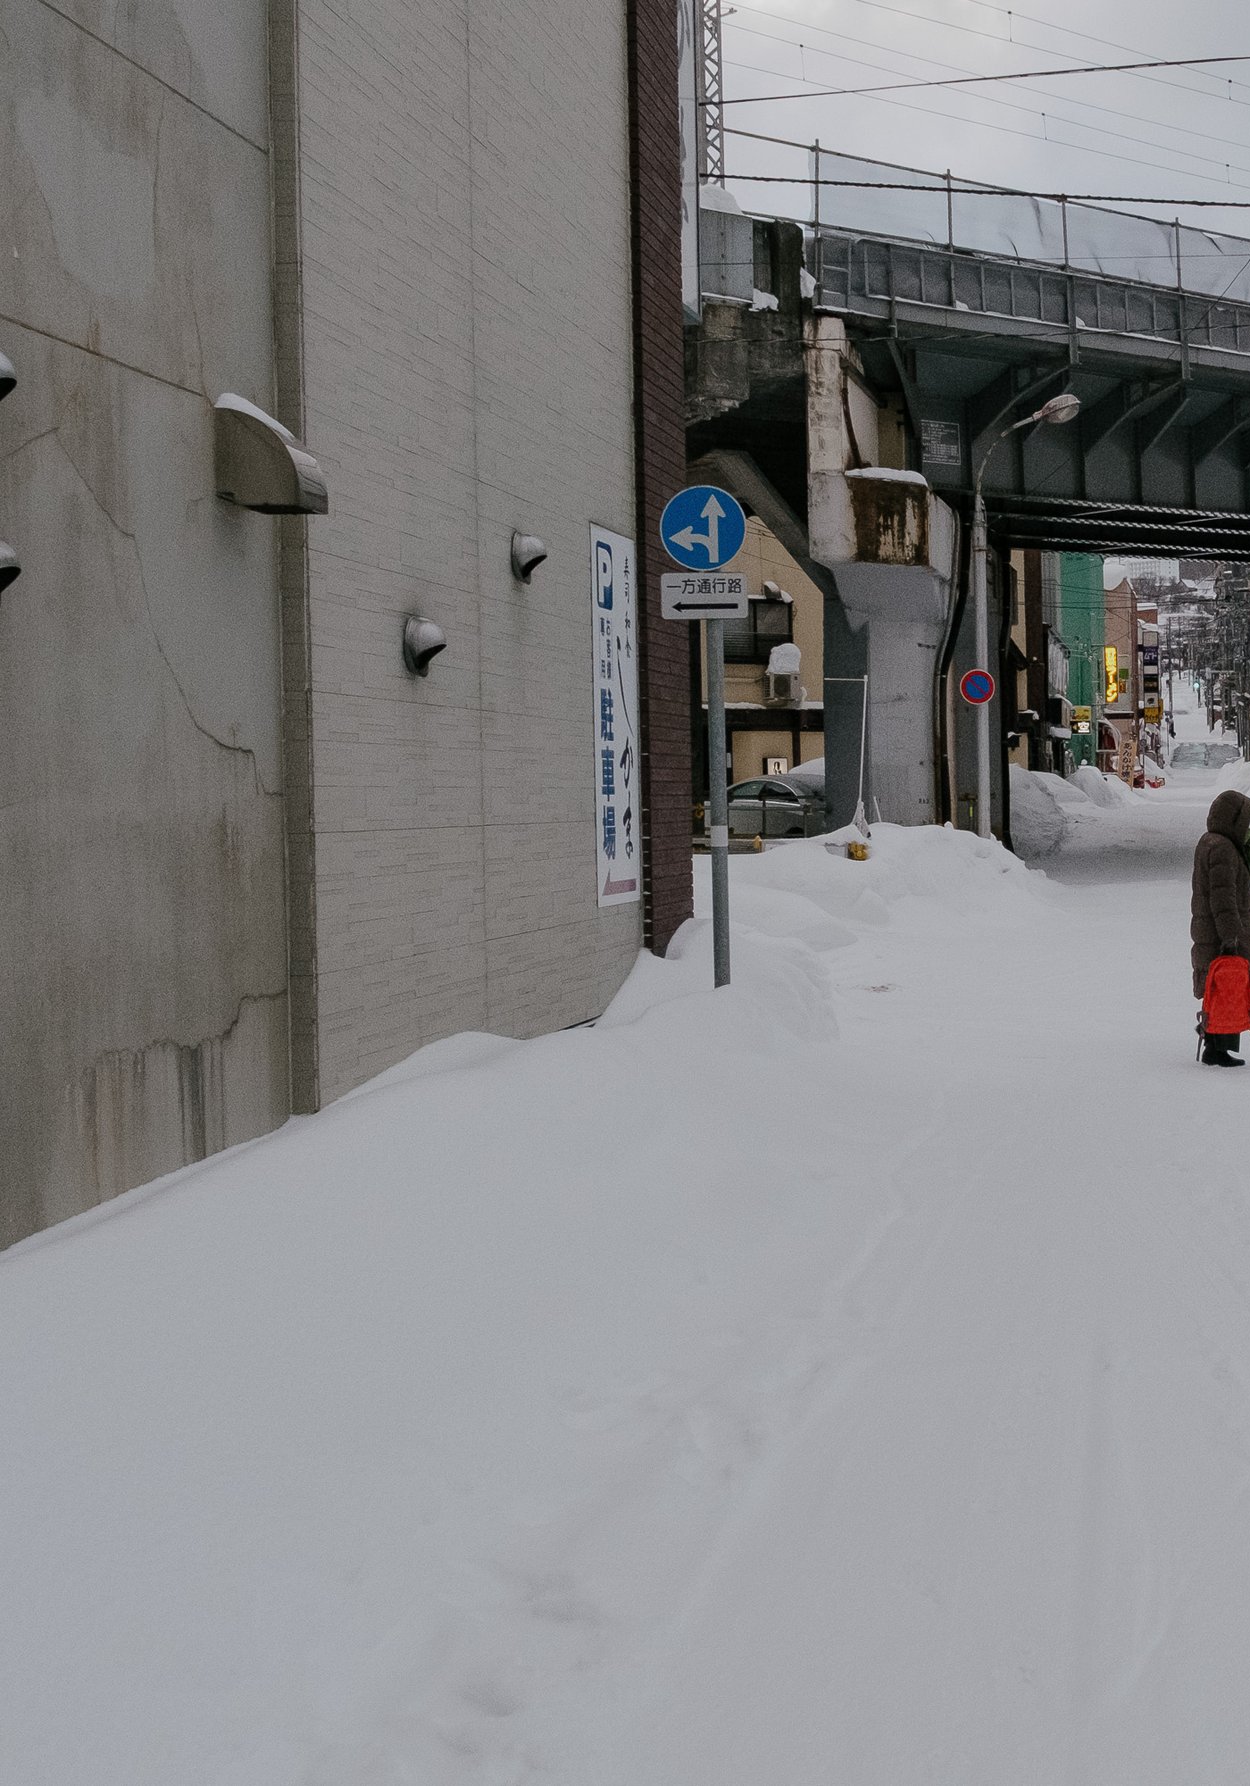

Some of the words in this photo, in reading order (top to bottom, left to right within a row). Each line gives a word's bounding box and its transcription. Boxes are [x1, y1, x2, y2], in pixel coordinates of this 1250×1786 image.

[597, 542, 613, 609] P
[666, 578, 742, 594] 一方通行路
[1105, 647, 1117, 702] ラーメン
[600, 688, 616, 860] 駐車場
